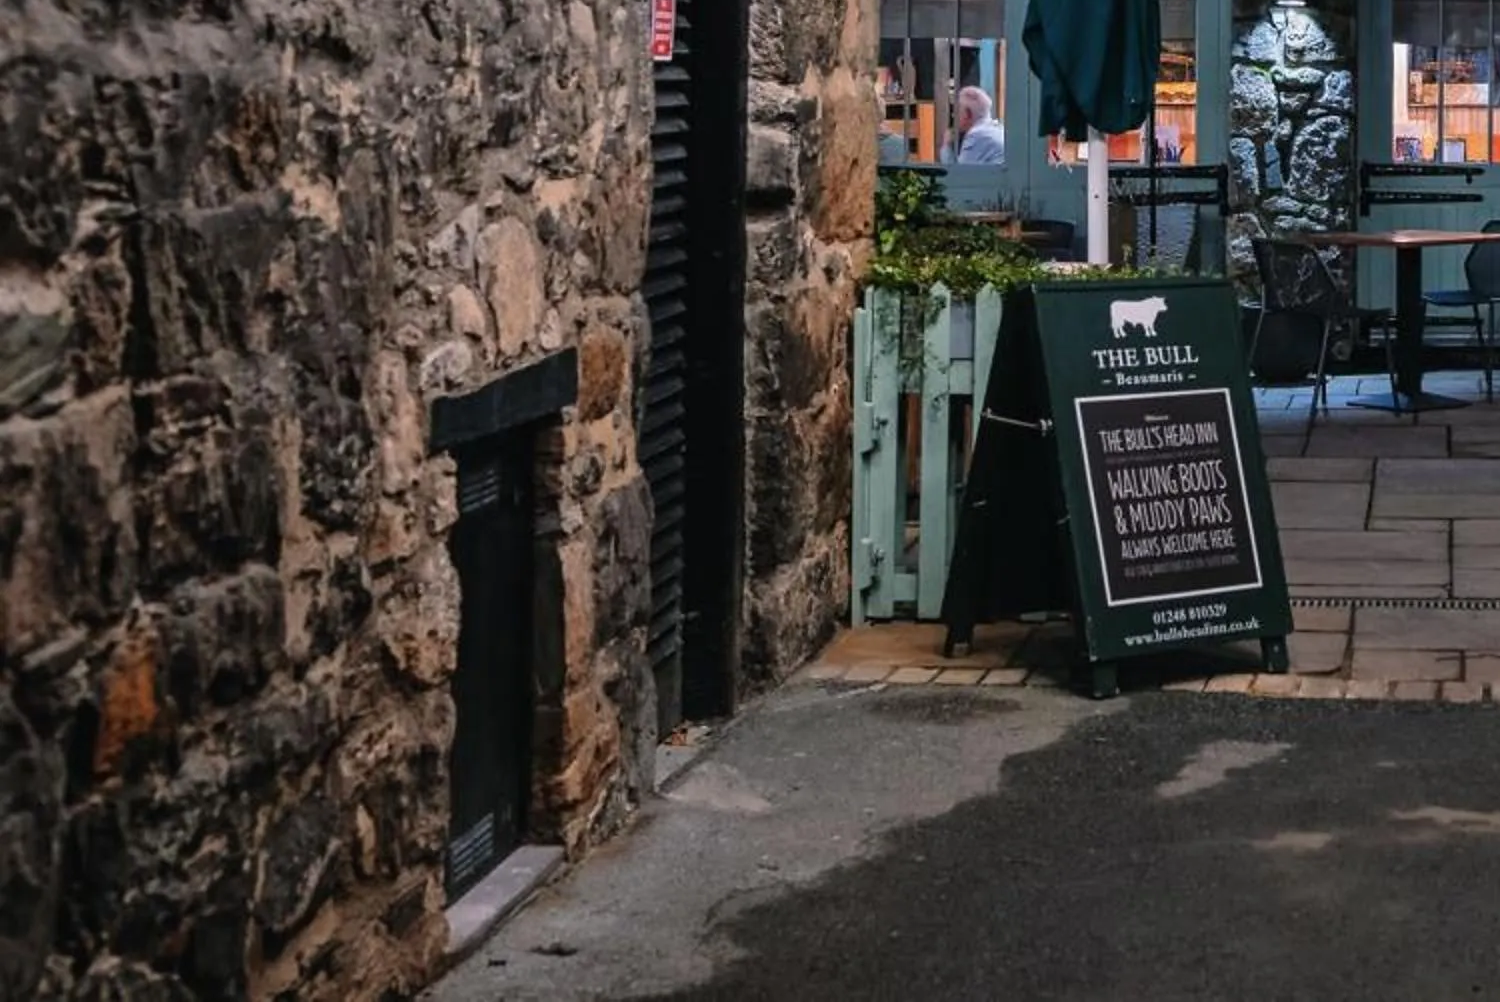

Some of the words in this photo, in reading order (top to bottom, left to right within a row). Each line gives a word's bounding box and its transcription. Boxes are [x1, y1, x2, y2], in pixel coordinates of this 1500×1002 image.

[1092, 348, 1140, 369] THE
[1144, 345, 1199, 366] BULL
[1098, 429, 1124, 453] THE
[1163, 423, 1195, 447] HEAD
[1195, 421, 1219, 445] INN
[1107, 463, 1178, 500] WALKING
[1178, 459, 1227, 493] BOOTS
[1113, 505, 1129, 535] &
[1129, 498, 1186, 533] MUDDY
[1188, 494, 1232, 526] PAWS
[1121, 537, 1160, 559] ALWAYS
[1160, 530, 1209, 555] WELCOME
[1209, 527, 1236, 549] HERE
